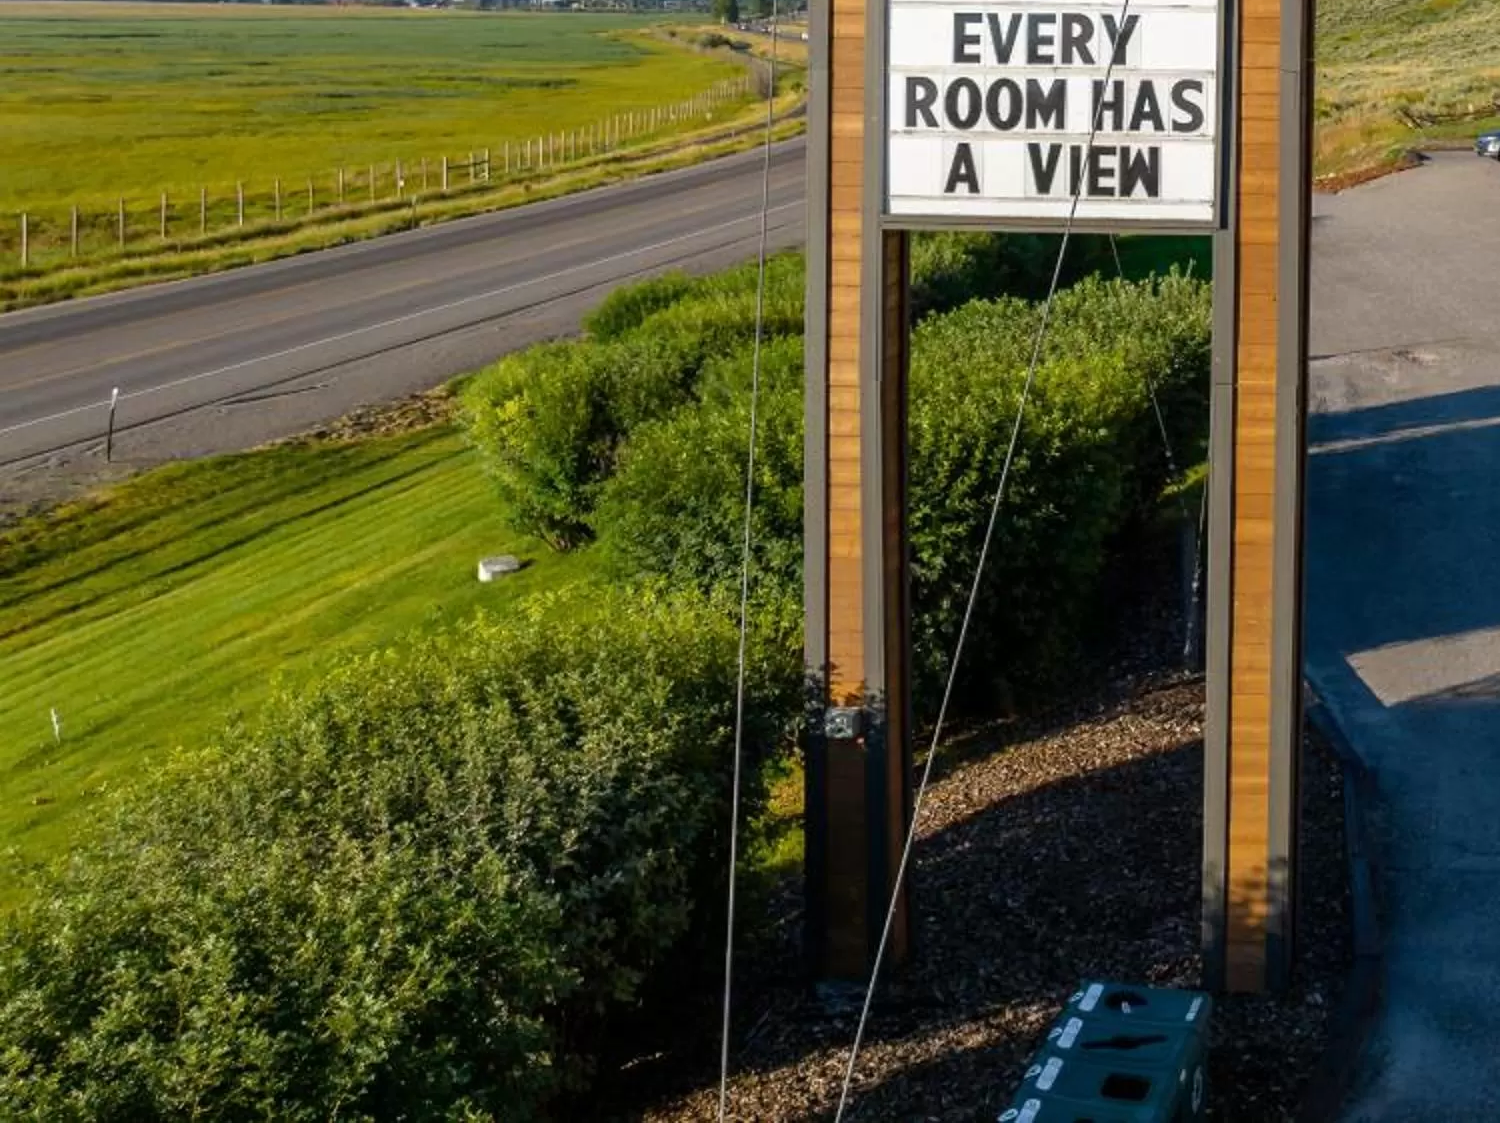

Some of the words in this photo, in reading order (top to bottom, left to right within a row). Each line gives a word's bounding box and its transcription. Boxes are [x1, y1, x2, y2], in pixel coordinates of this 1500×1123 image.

[953, 12, 1141, 65] EVERY
[905, 76, 1067, 130] ROOM
[1091, 79, 1205, 132] HAS
[944, 142, 980, 194] A
[1027, 142, 1161, 197] VIEW
